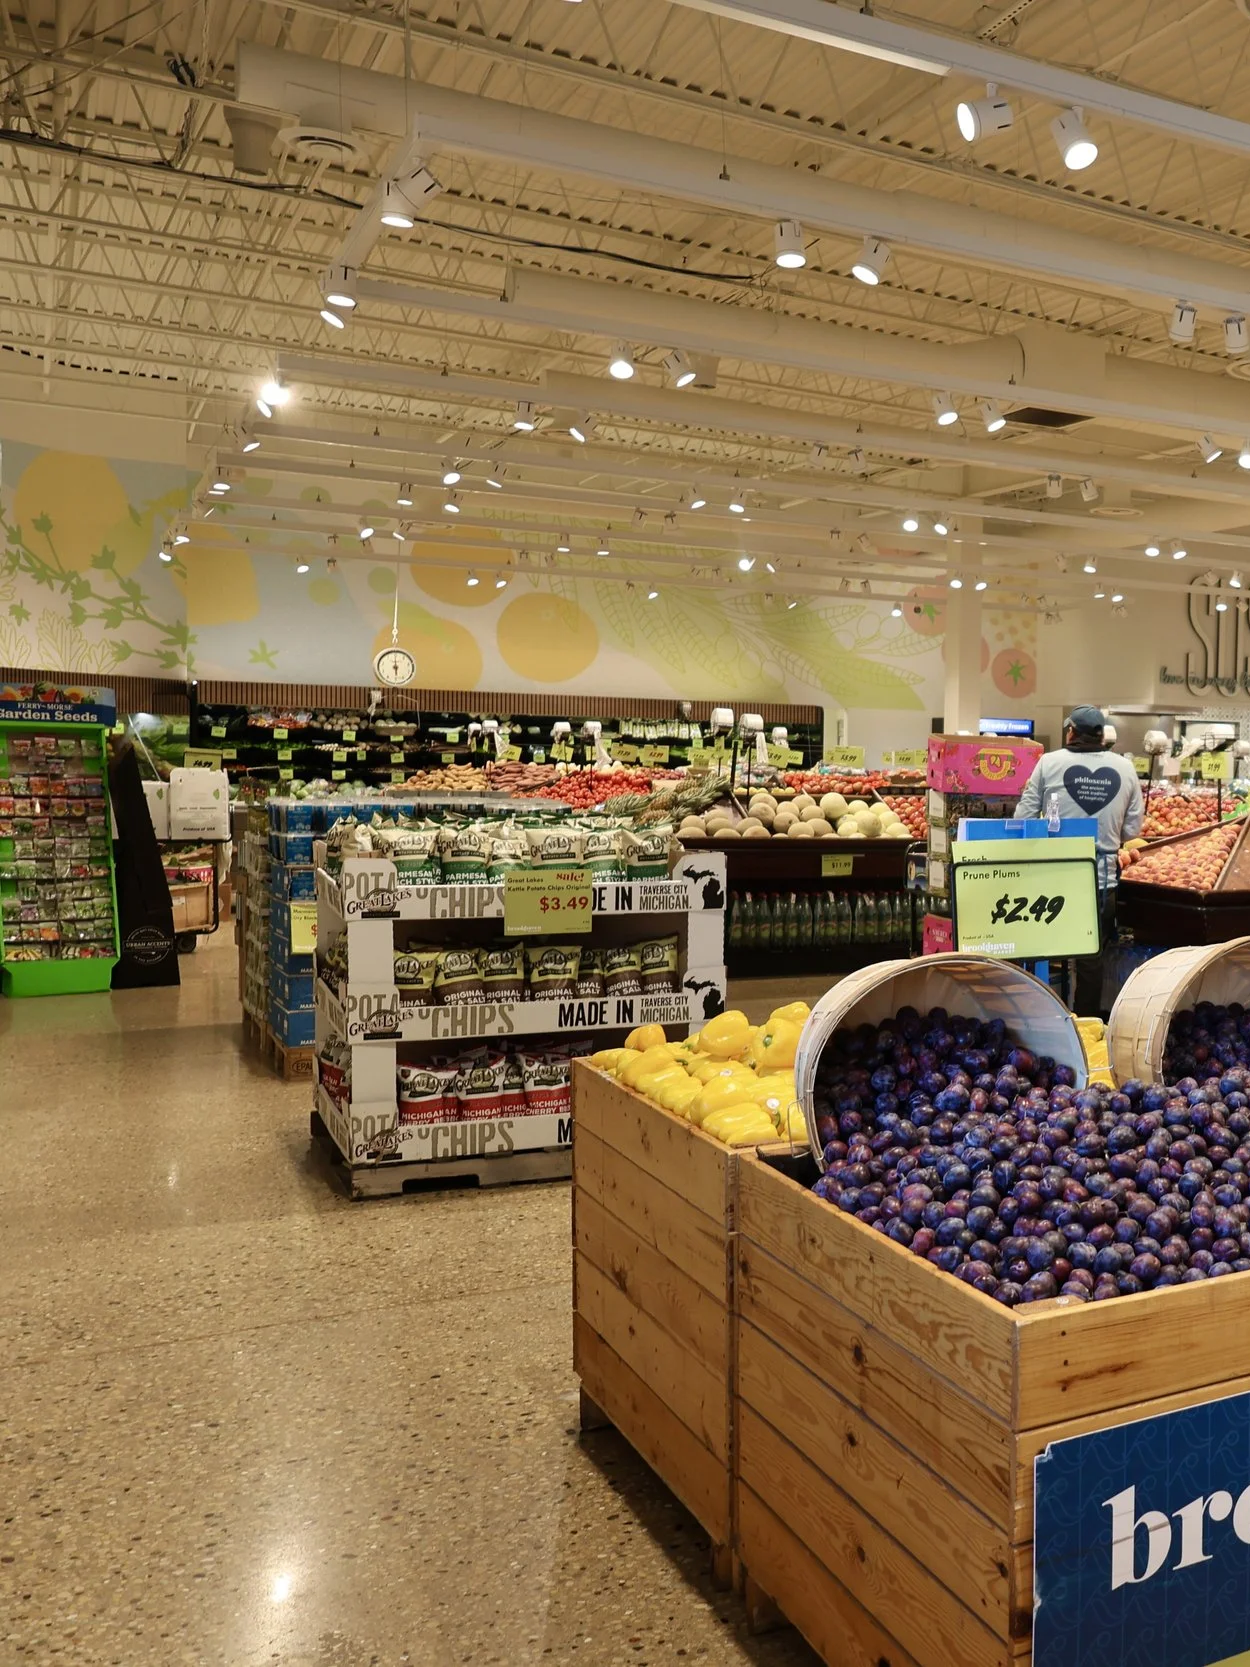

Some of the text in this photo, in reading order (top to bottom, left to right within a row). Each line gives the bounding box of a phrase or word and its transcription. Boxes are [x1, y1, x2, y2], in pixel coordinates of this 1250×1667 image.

[55, 711, 98, 722] Seeds
[508, 876, 524, 884] Great
[556, 872, 584, 882] sale!
[963, 870, 1020, 880] Prune Plums
[566, 884, 590, 892] Original
[640, 884, 688, 896] TRAVERSE CITY
[614, 886, 632, 910] IN
[639, 896, 692, 911] MICHIGAN.
[539, 896, 588, 914] $3.49
[991, 894, 1065, 925] $2.49
[962, 942, 1016, 954] brookhaven
[640, 996, 688, 1008] TRAVERSE CITY
[558, 1000, 634, 1028] MADE IN
[640, 1006, 692, 1024] MICHIGAN.
[432, 1004, 514, 1038] CHIPS
[432, 1120, 514, 1160] CHIPS
